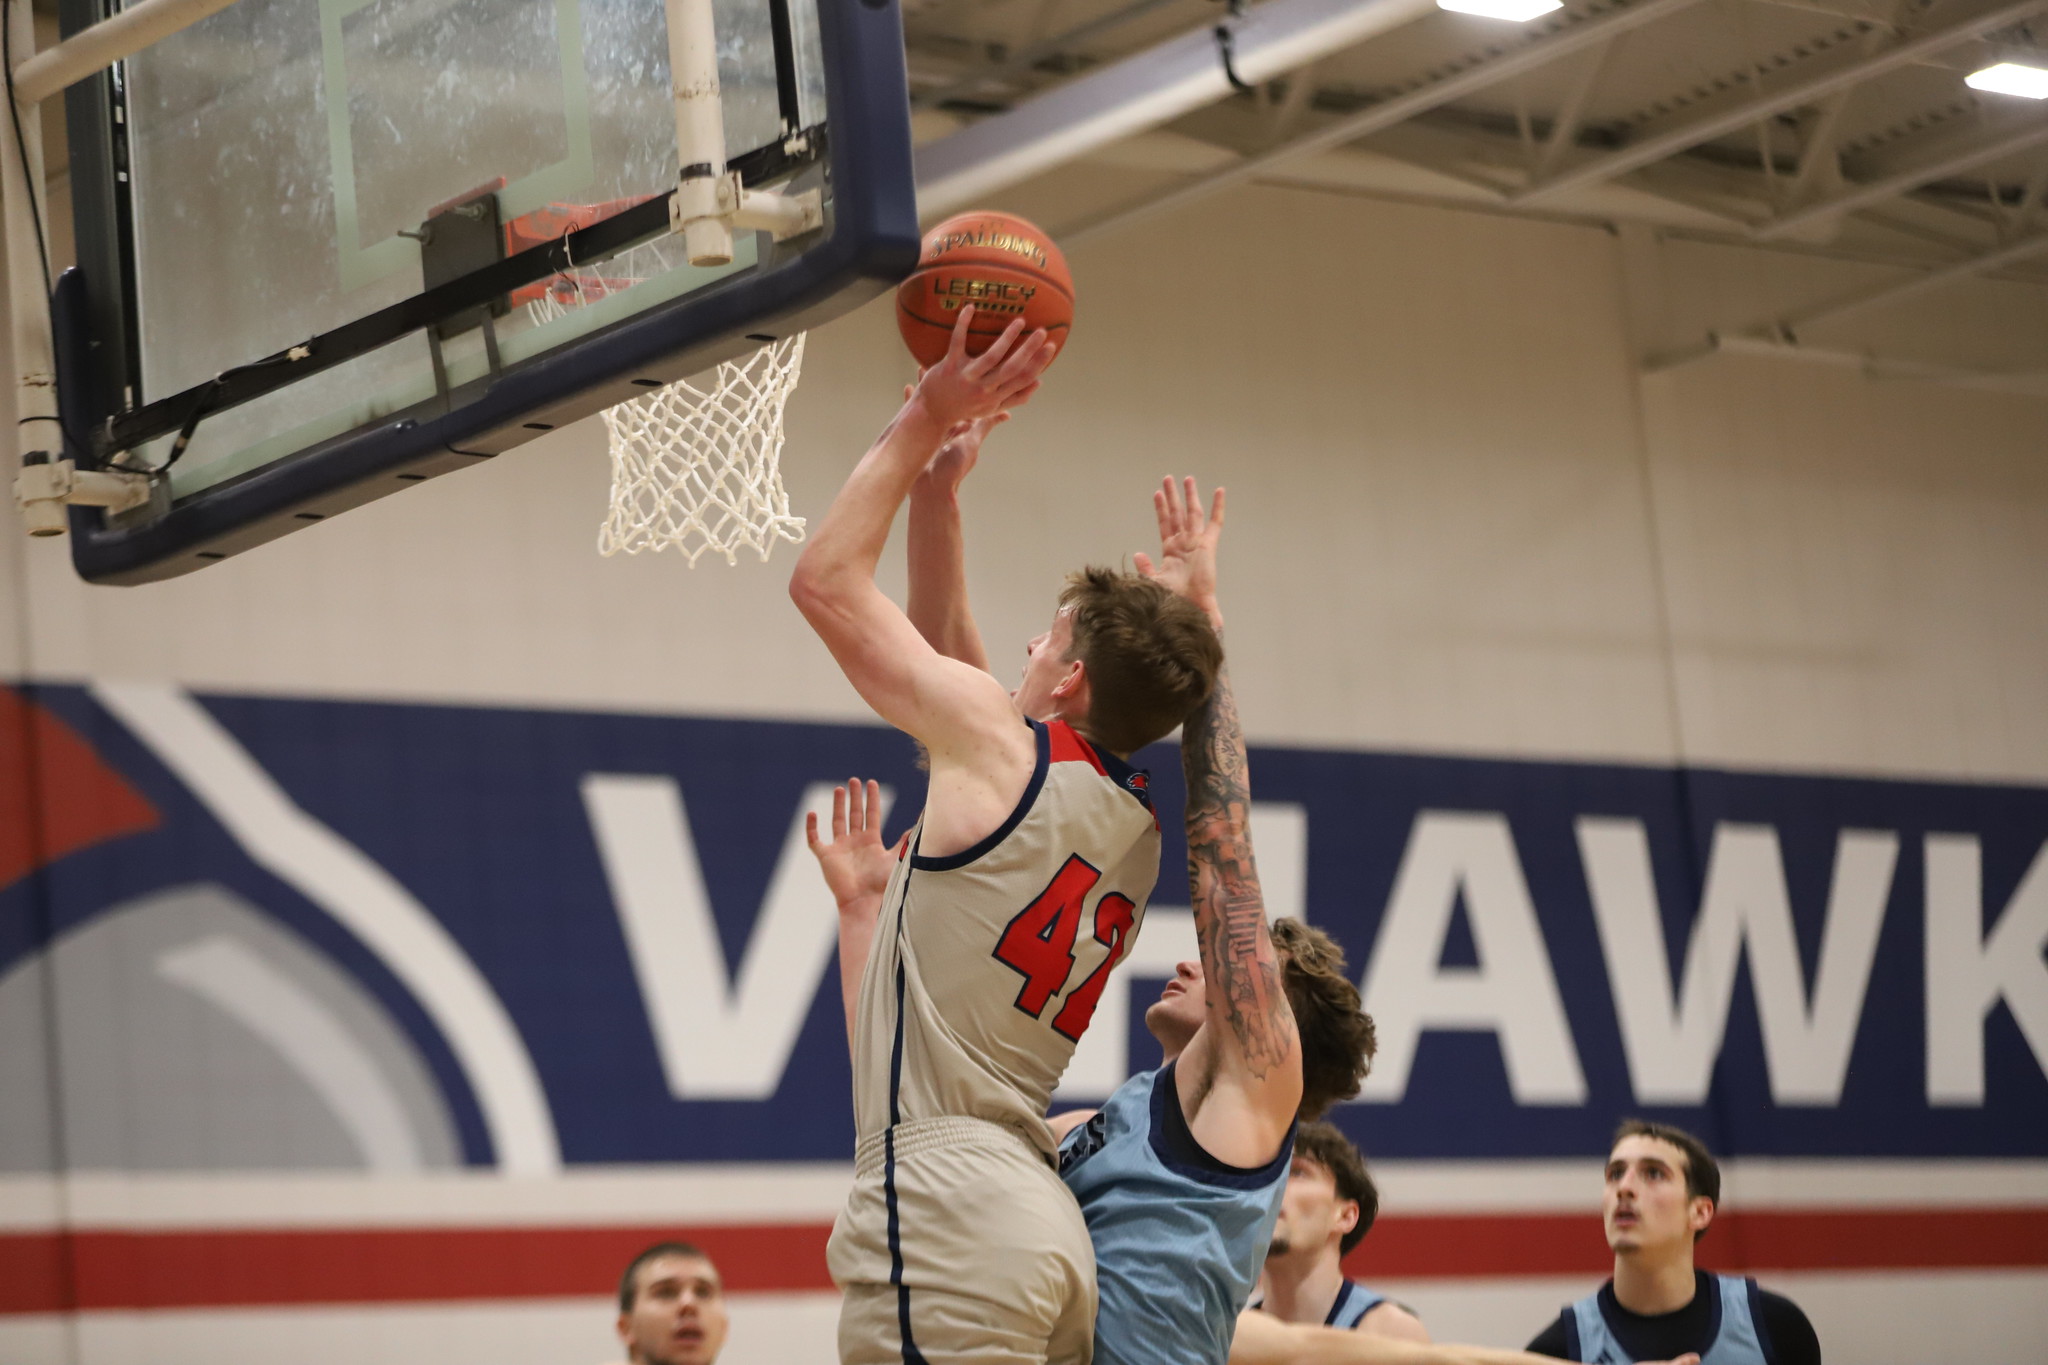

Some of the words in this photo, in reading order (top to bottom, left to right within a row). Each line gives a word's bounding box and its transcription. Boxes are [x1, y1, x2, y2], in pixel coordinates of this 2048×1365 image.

[930, 229, 1047, 271] SPALDING
[934, 277, 1036, 302] LEGACY
[992, 852, 1136, 1045] 42
